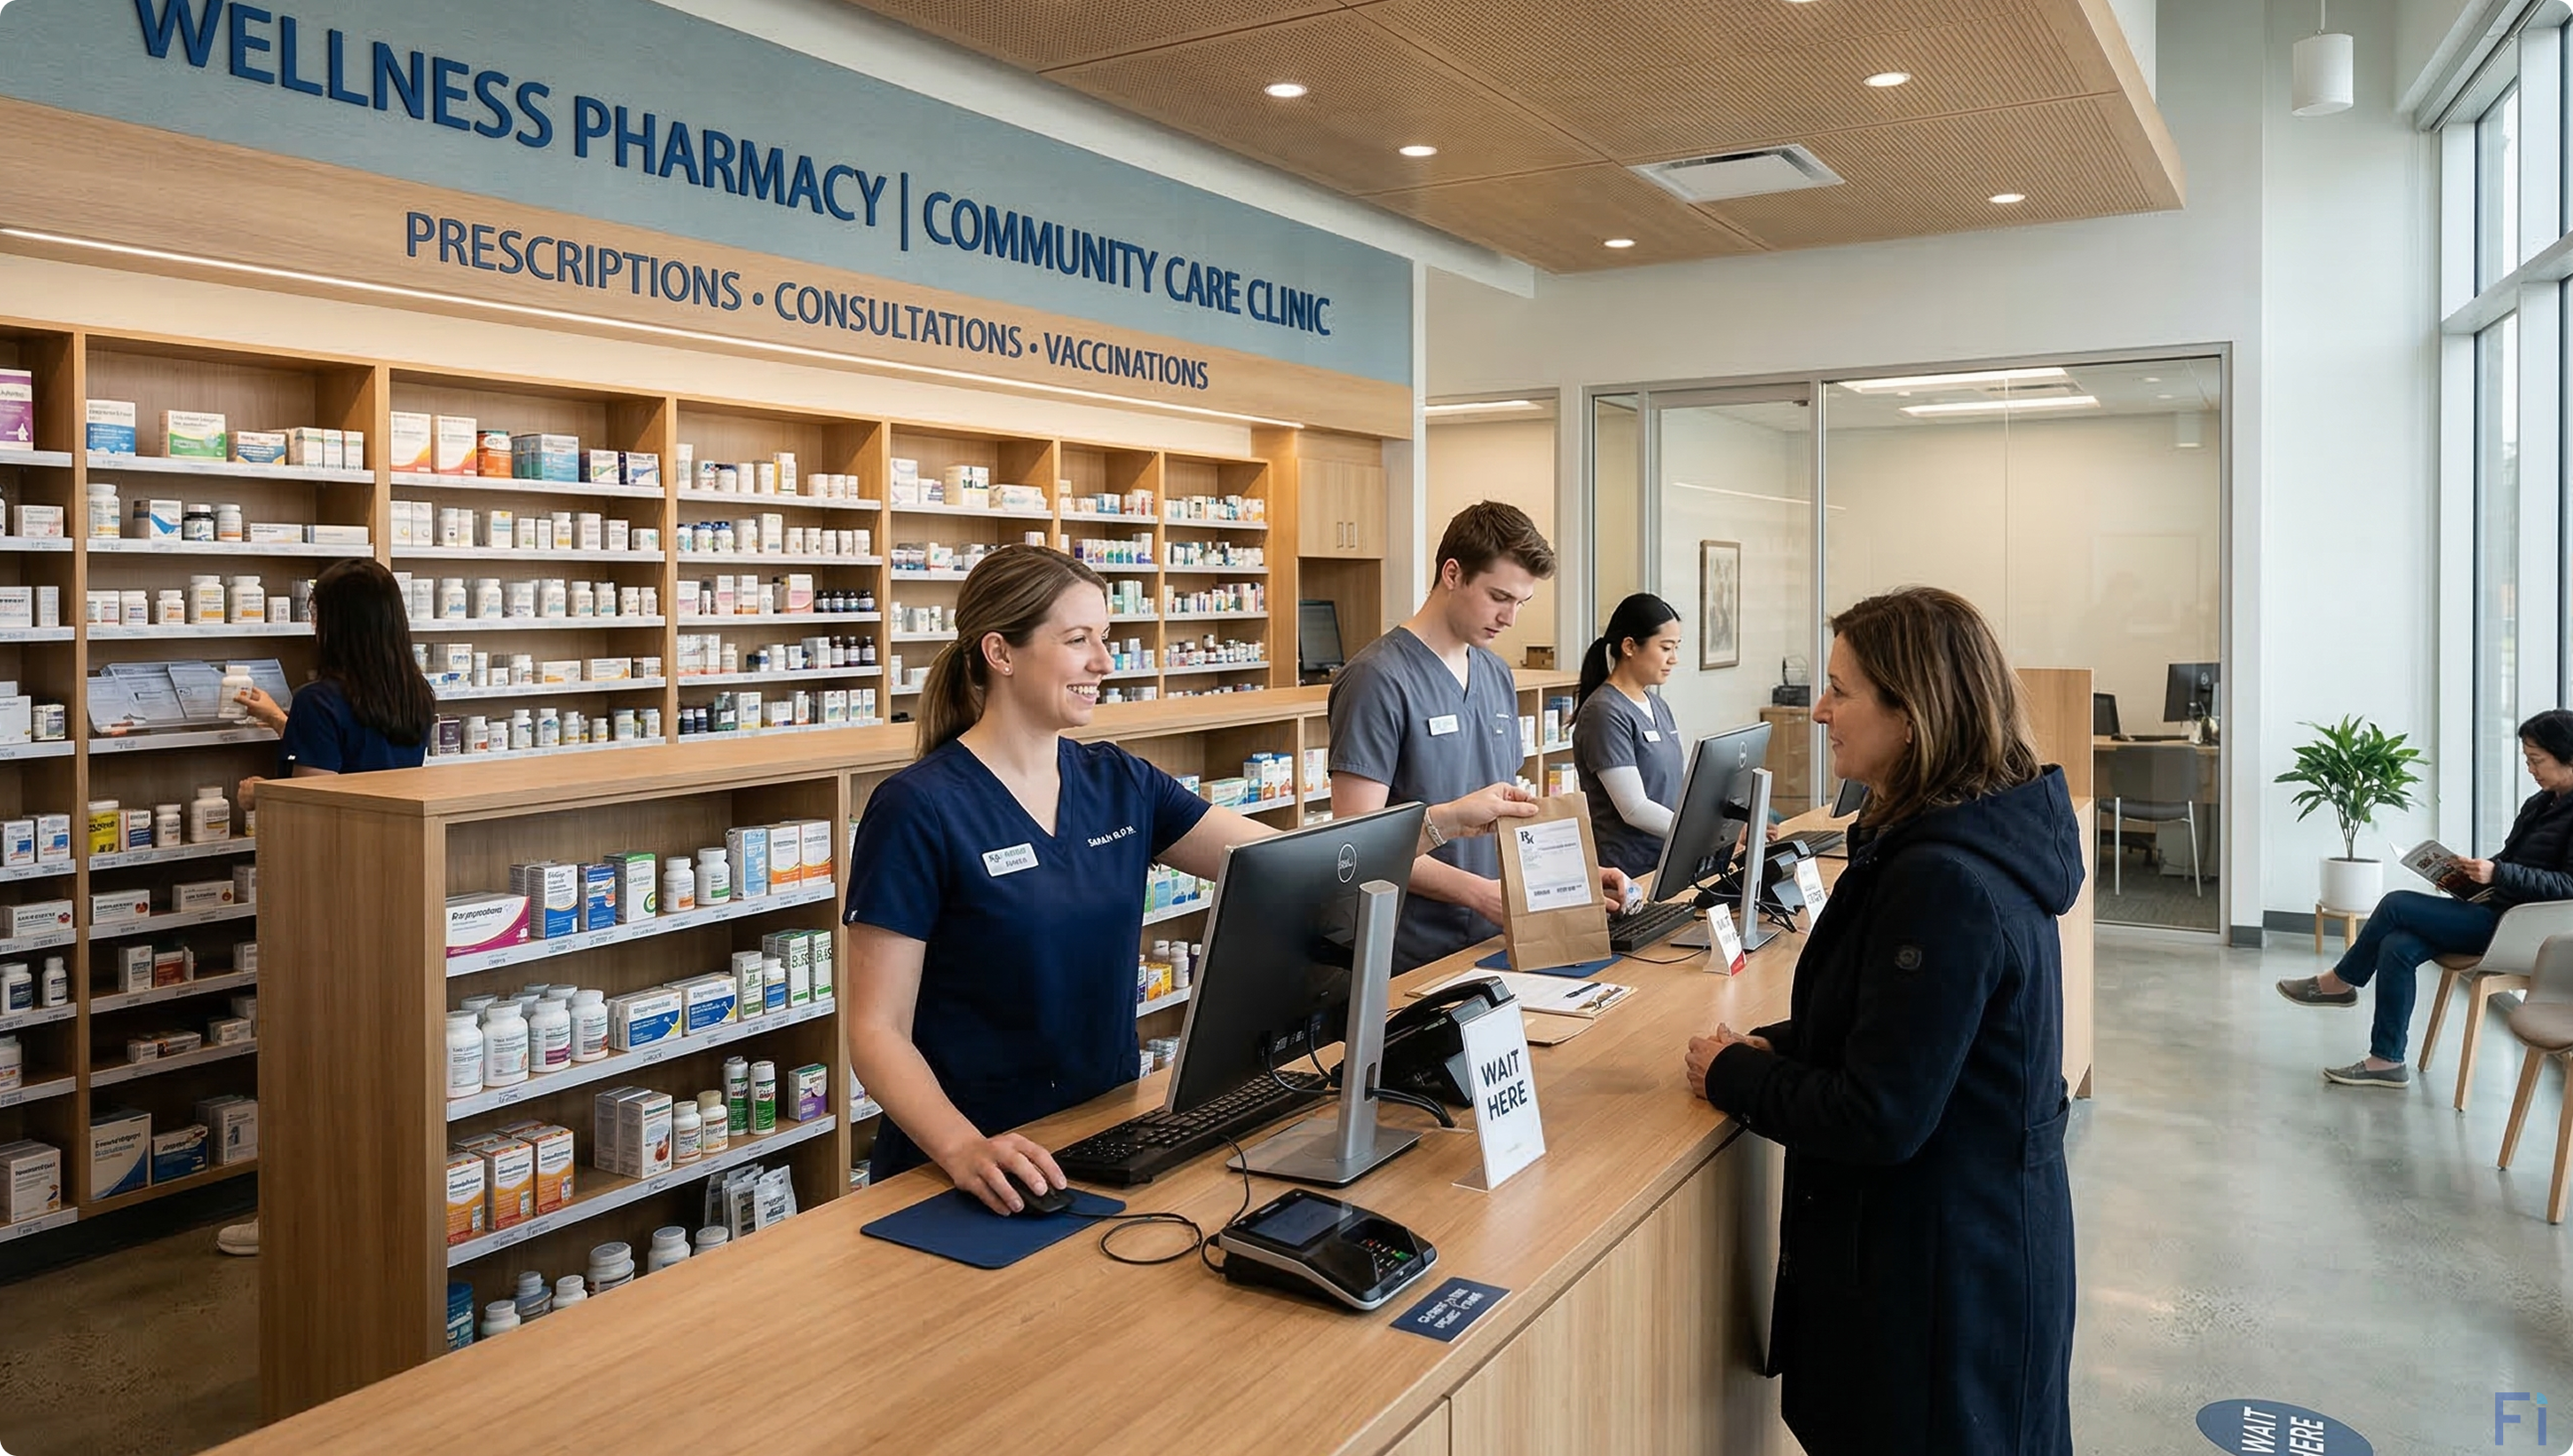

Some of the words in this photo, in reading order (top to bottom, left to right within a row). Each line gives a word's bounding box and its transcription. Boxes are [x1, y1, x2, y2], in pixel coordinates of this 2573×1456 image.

[135, 0, 553, 148] WELLNESS
[575, 95, 886, 226] PHARMACY
[924, 192, 1158, 292] COMMUNITY
[1165, 256, 1241, 315] CARE
[1247, 279, 1331, 337] CLINIC
[406, 211, 742, 312] PRESCRIPTIONS
[774, 282, 1023, 358] CONSULTATIONS
[1044, 332, 1209, 391] VACCINATIONS
[1481, 1049, 1519, 1088] WAIT
[1487, 1079, 1528, 1121] HERE
[2242, 1406, 2277, 1453] WAIT
